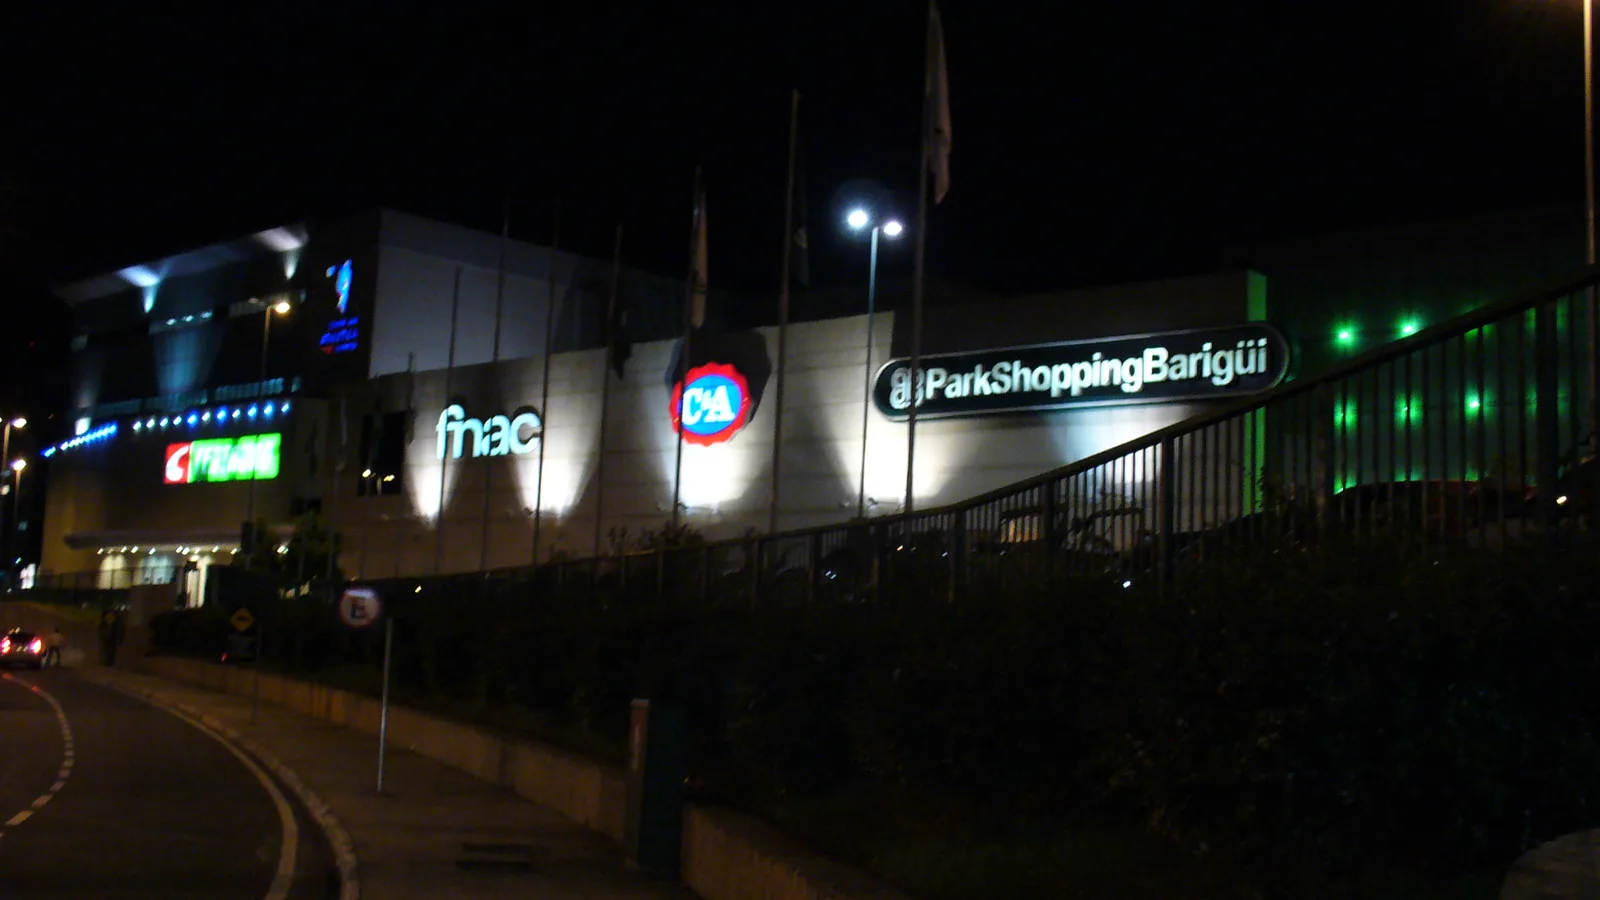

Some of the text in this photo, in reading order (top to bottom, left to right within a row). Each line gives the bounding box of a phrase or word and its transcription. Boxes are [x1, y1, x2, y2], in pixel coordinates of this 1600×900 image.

[926, 338, 1268, 400] ParkShoppingBarigüi
[435, 403, 542, 460] fnac
[682, 385, 736, 425] C&A
